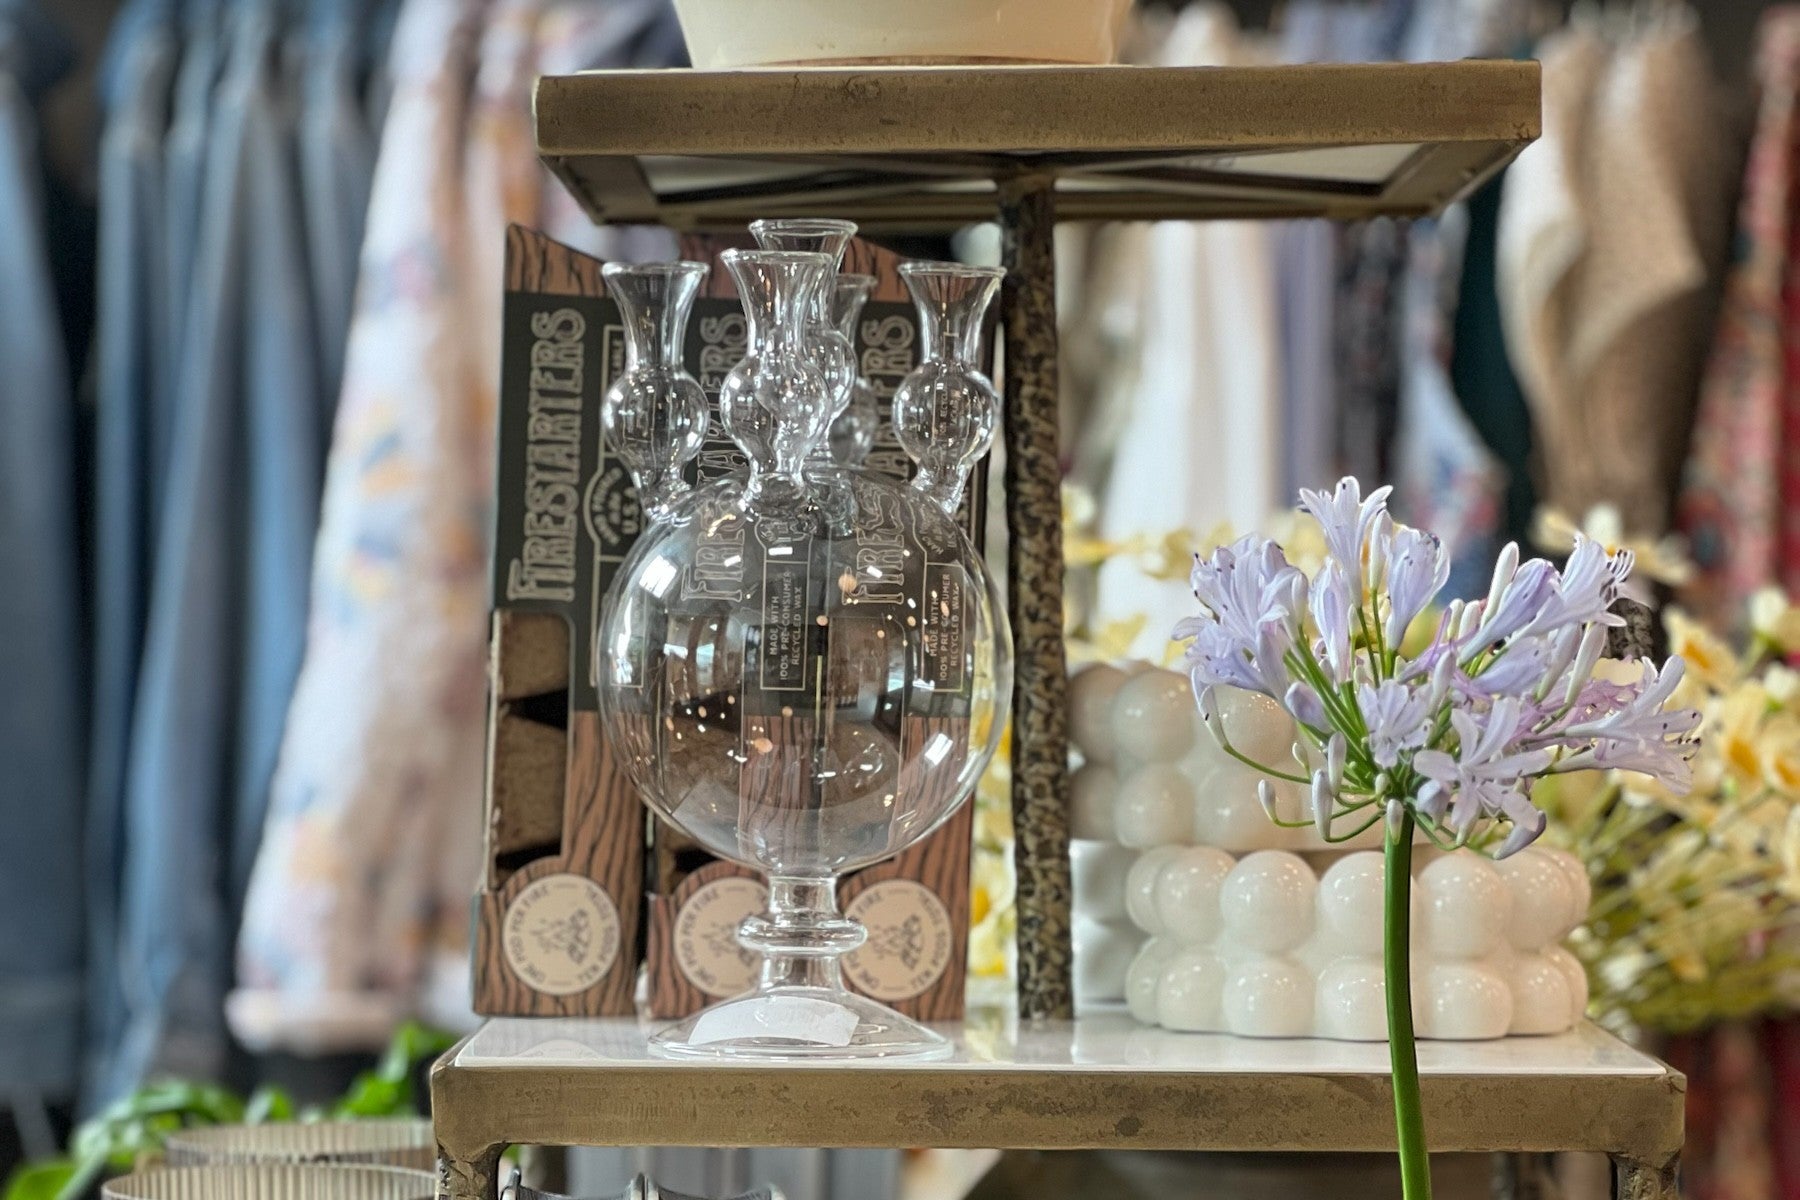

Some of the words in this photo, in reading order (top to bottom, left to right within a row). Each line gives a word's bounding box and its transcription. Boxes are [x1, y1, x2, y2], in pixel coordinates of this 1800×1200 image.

[507, 308, 586, 601] FIRESTARTERS
[771, 596, 779, 623] WITH
[781, 571, 792, 650] PRE-CONSUMER
[795, 587, 803, 608] WAX
[932, 599, 940, 624] WITH
[941, 574, 950, 650] PRE-COSUMER
[770, 628, 779, 656] MADE
[792, 614, 800, 665] RECYCLED
[930, 631, 938, 657] MADE
[950, 616, 958, 666] RECYCLED
[780, 655, 788, 680] 100%
[940, 655, 948, 681] 100%
